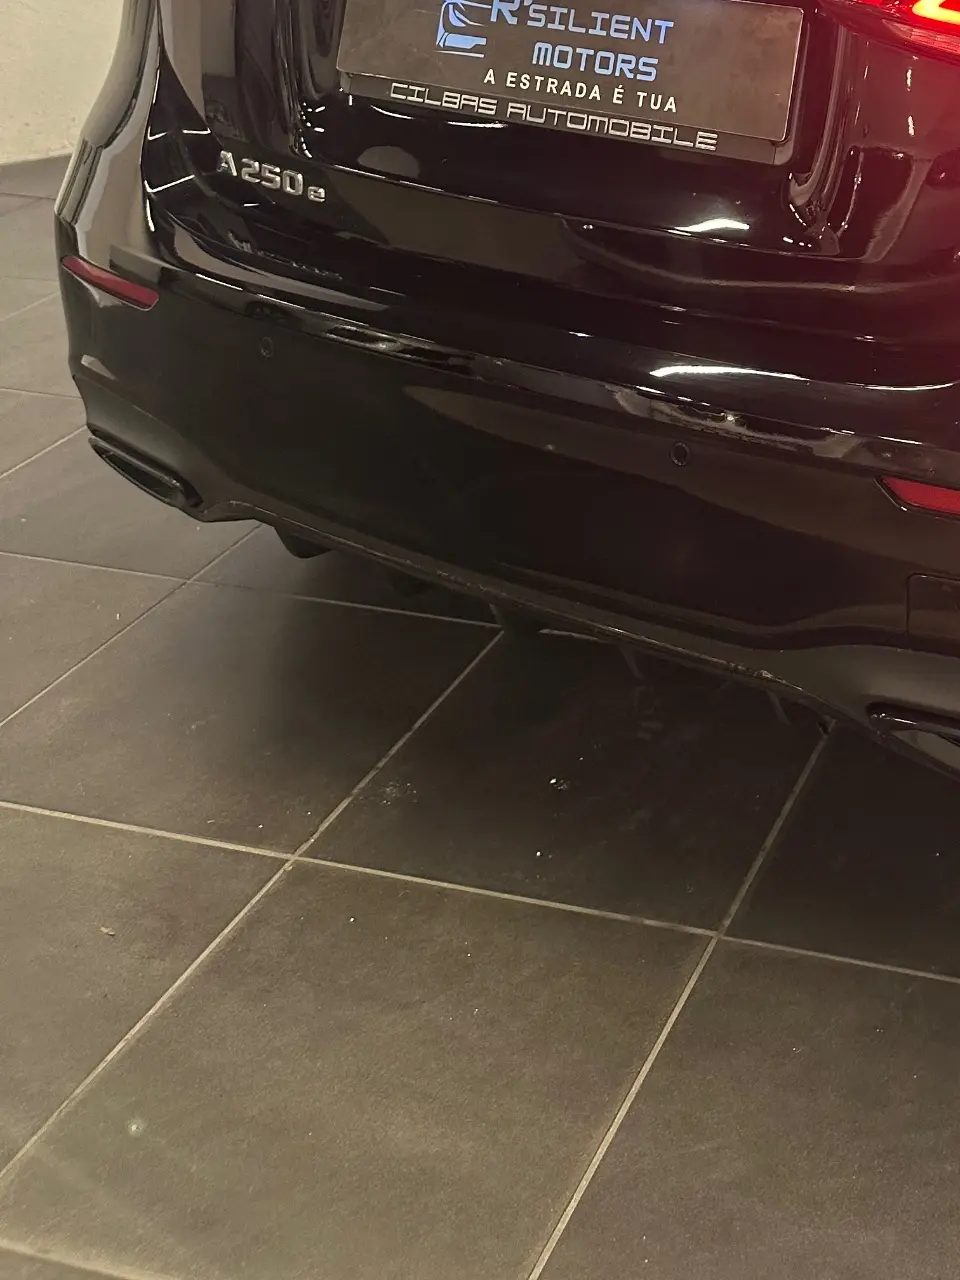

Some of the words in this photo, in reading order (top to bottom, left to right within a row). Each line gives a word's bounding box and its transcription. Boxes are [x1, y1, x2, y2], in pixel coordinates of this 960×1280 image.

[532, 42, 658, 82] MOTORS
[483, 69, 496, 85] A
[506, 72, 601, 101] ESTRADA
[613, 85, 624, 105] É
[636, 91, 678, 113] TUA
[506, 103, 718, 151] AUTOMOBILE
